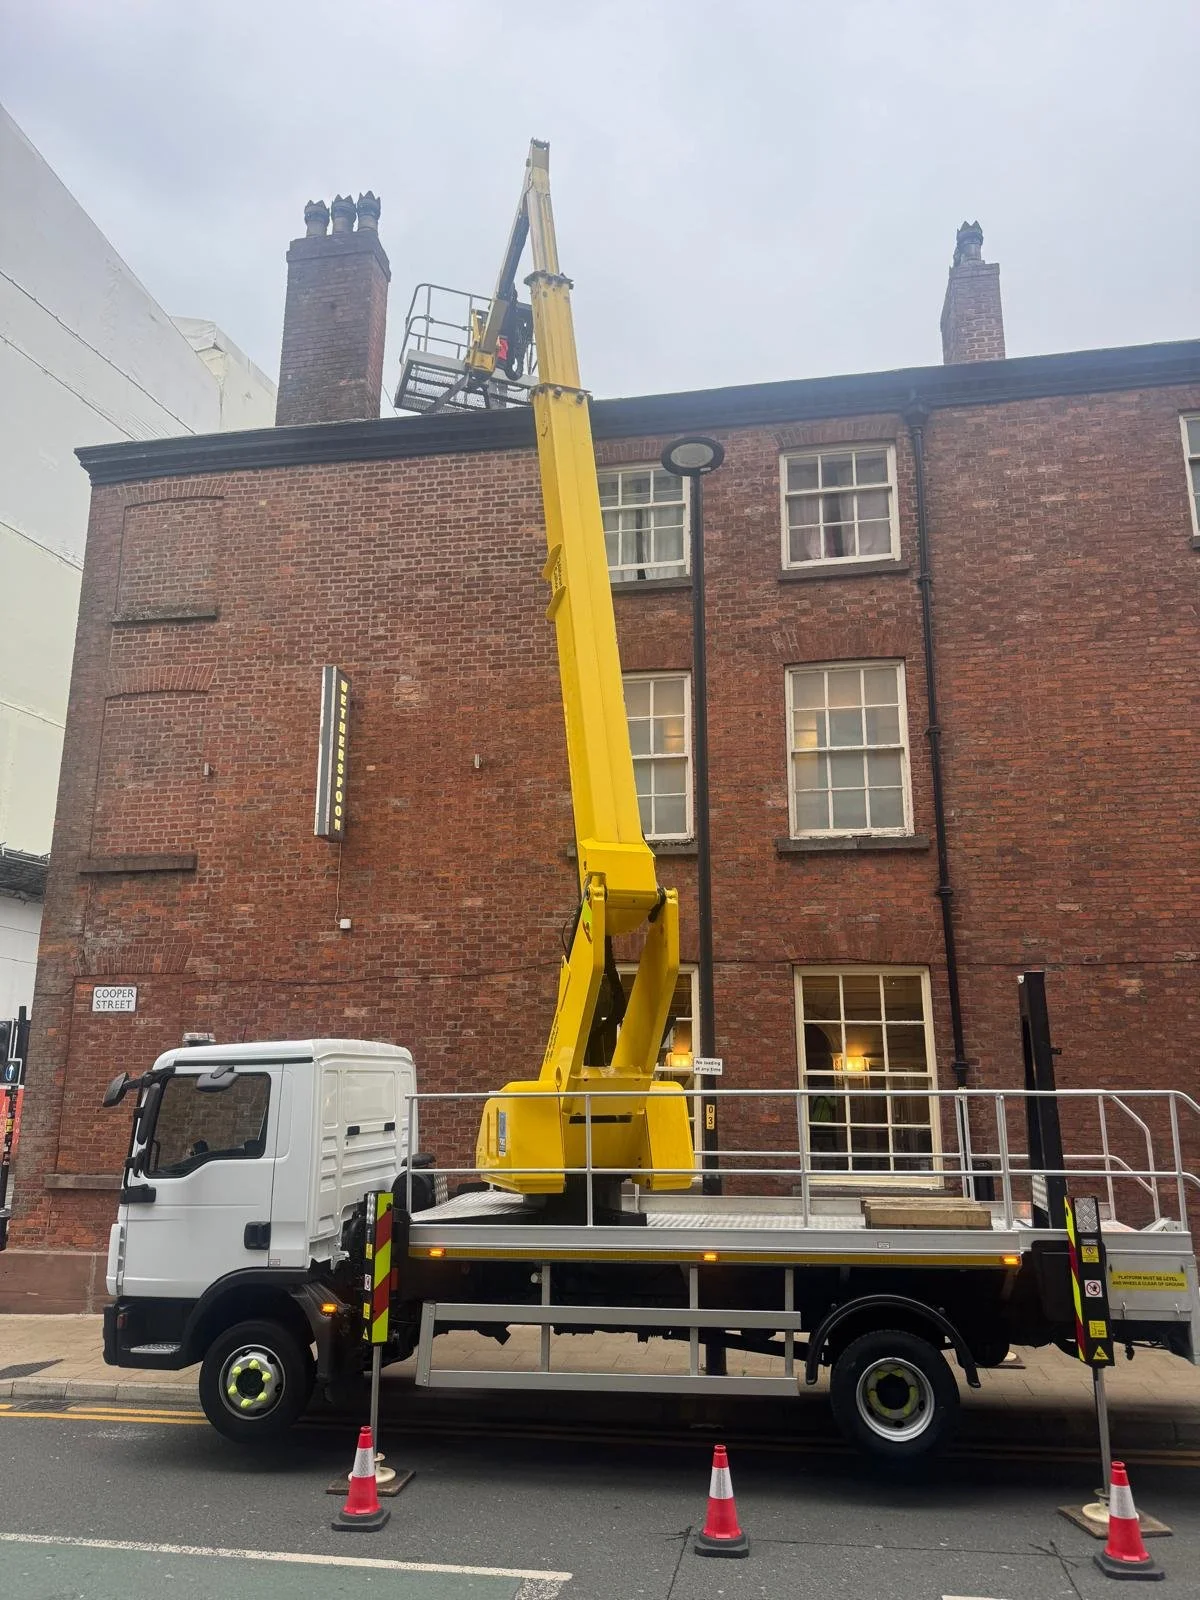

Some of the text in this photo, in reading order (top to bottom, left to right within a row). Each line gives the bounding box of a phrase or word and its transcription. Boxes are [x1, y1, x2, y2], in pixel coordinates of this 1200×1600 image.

[333, 679, 348, 831] WETHERSPOON
[95, 989, 134, 998] COOPER
[95, 1000, 132, 1009] STREET
